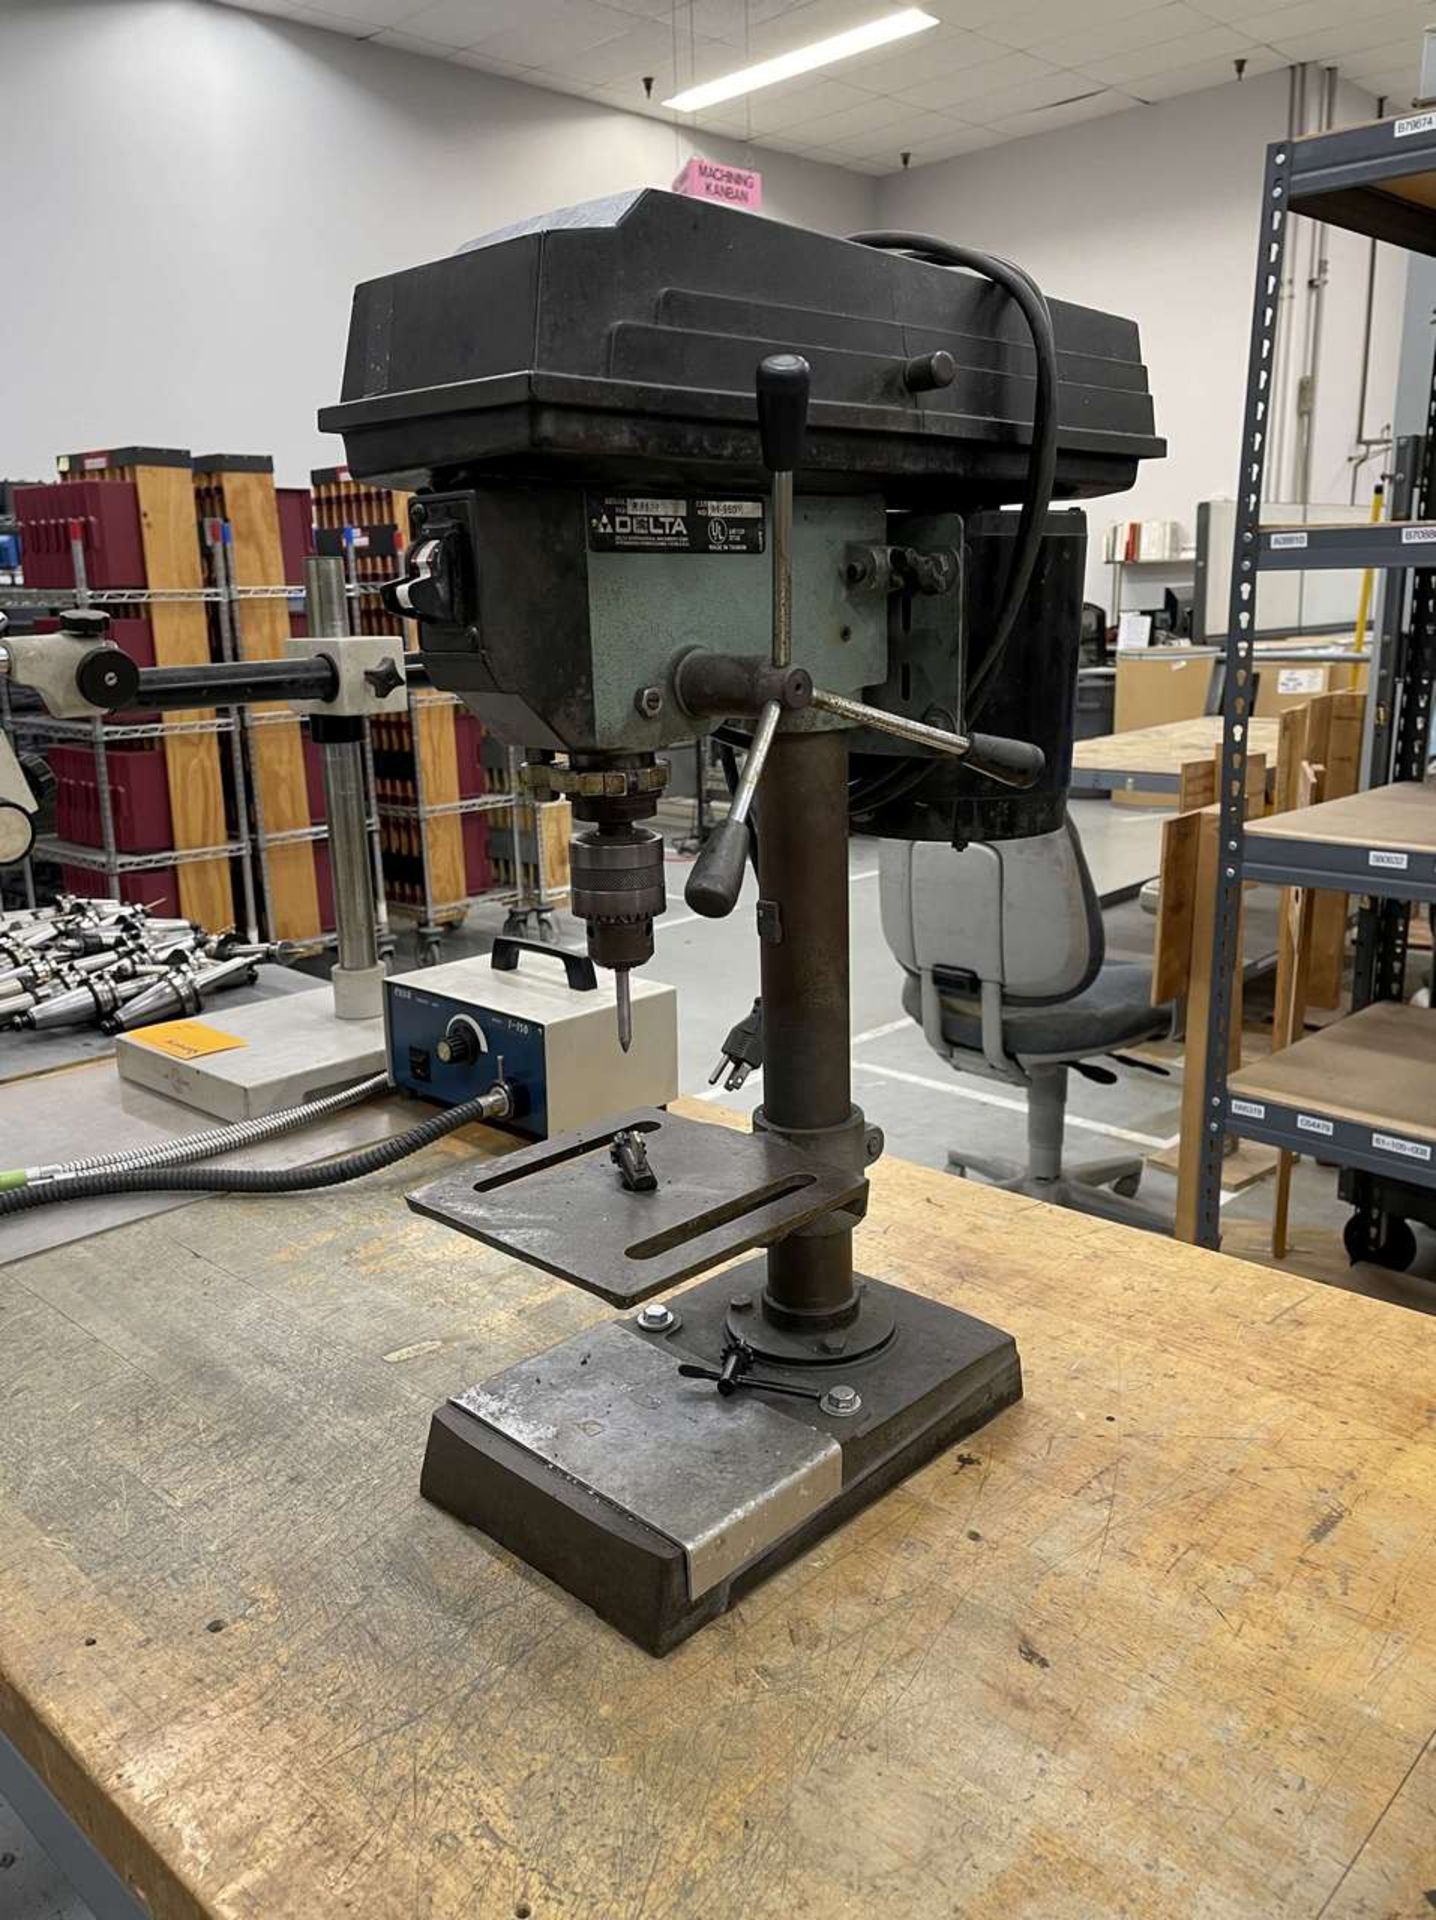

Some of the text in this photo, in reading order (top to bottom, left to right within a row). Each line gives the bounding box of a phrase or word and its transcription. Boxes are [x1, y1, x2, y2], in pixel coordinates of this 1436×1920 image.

[698, 163, 755, 190] MACHINING
[704, 181, 749, 203] KANBAN
[615, 515, 688, 535] DELTA
